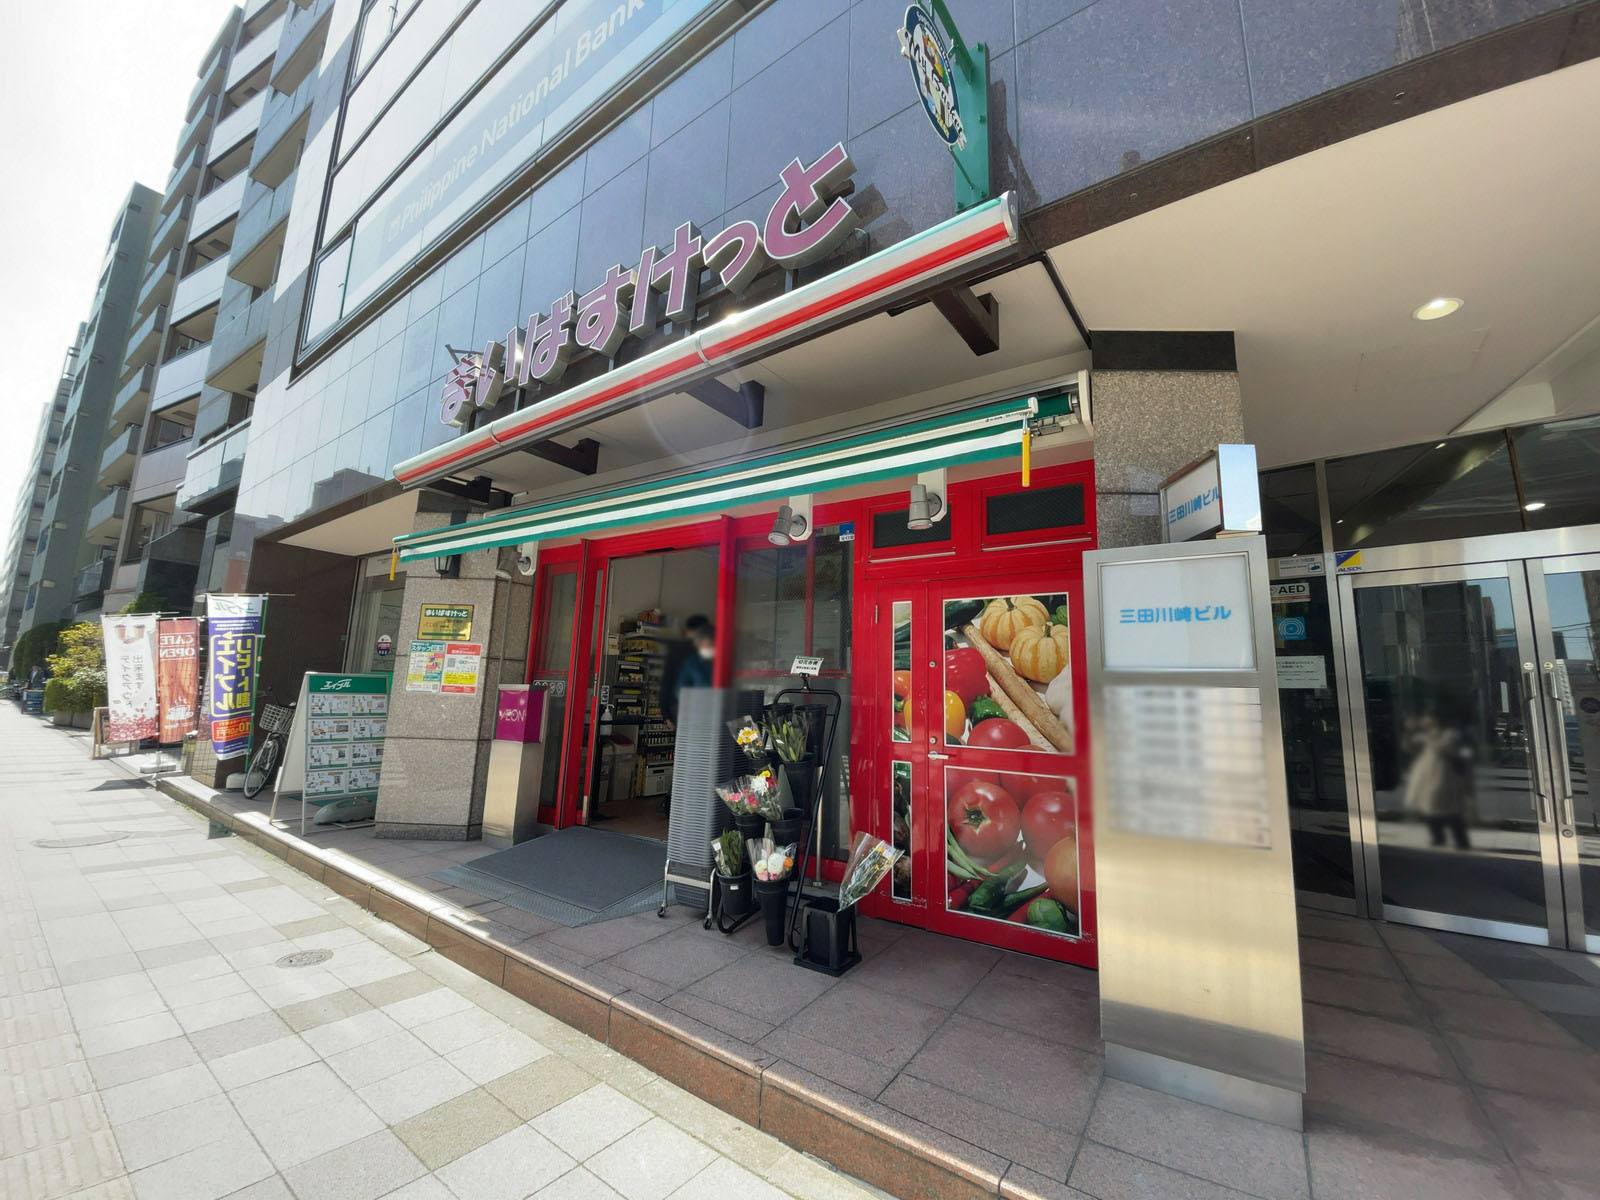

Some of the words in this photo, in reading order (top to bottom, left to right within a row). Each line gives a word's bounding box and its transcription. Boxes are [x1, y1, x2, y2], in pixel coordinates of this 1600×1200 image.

[401, 144, 479, 234] Philippine
[480, 48, 571, 156] National
[574, 0, 646, 69] Bank
[903, 30, 927, 76] My
[440, 141, 853, 426] まいばすけっと
[1278, 584, 1307, 594] AED
